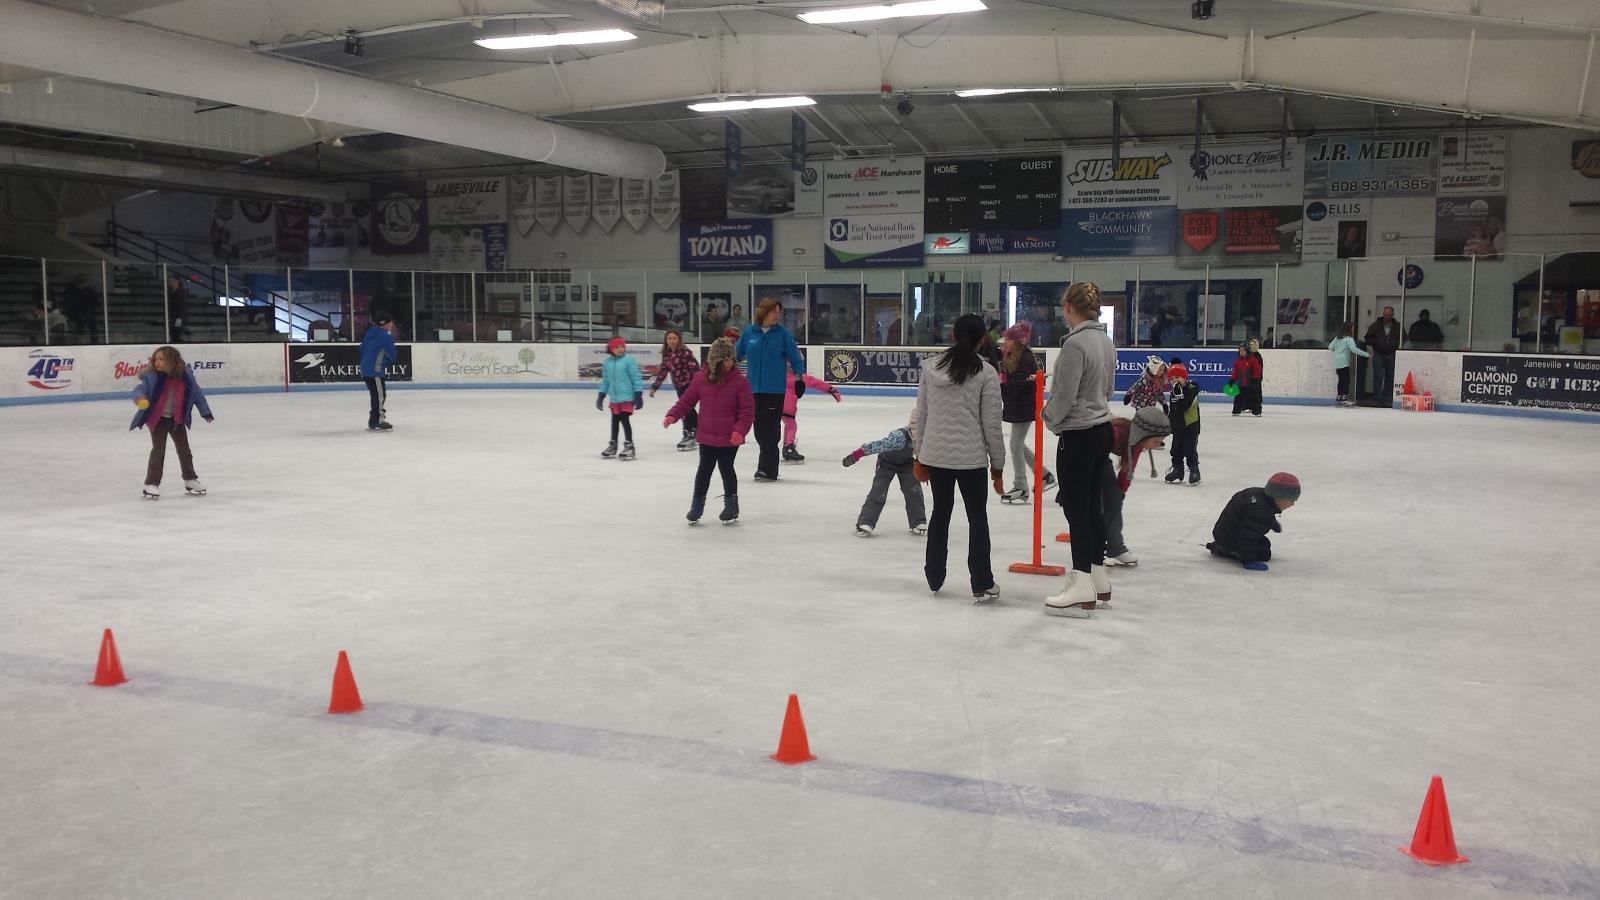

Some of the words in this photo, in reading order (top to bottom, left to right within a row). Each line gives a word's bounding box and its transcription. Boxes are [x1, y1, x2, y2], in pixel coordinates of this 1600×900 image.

[1313, 144, 1350, 161] J.R.
[1358, 141, 1431, 160] MEDIA
[934, 165, 958, 174] HOME
[1021, 160, 1053, 170] GUEST
[1068, 153, 1172, 185] SUBWAY
[826, 172, 852, 180] Harris
[854, 167, 880, 179] ACE
[880, 168, 921, 177] Hardware
[433, 181, 500, 195] JANESVILLE
[1331, 179, 1429, 192] 608-931-1365
[1329, 203, 1361, 214] ELLIS
[1089, 210, 1153, 221] BLACKHAWK
[1188, 216, 1212, 226] FOX
[851, 224, 867, 233] First
[868, 222, 896, 232] National
[897, 222, 916, 231] Bank
[1088, 224, 1153, 234] COMMUNITY
[851, 232, 864, 241] and
[865, 232, 883, 241] Trust
[884, 232, 916, 243] Company
[688, 234, 767, 256] TOYLAND
[1014, 240, 1057, 249] BAYMONT
[861, 351, 910, 366] YOUR
[1524, 360, 1562, 368] Janesville
[194, 361, 223, 371] FLEET
[320, 365, 361, 376] BAKER
[447, 362, 490, 375] Green
[493, 362, 519, 375] East
[1189, 358, 1226, 372] STEIL
[1464, 371, 1518, 384] DIAMOND
[1468, 383, 1513, 395] CENTER
[1564, 377, 1600, 392] ICE?
